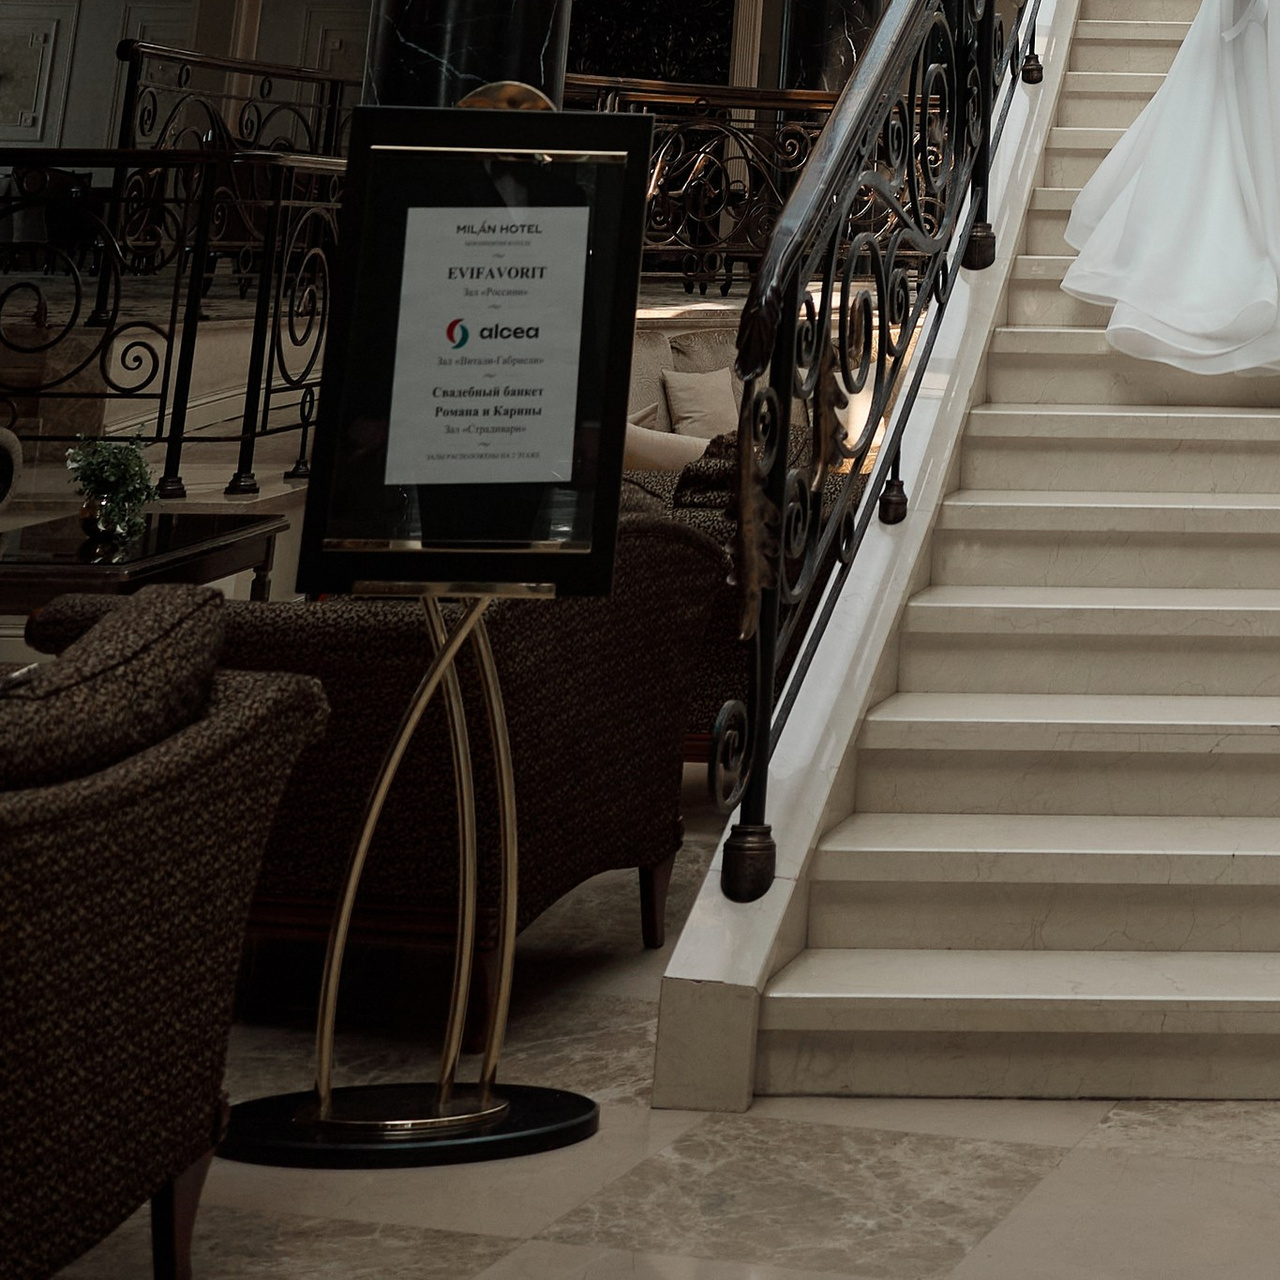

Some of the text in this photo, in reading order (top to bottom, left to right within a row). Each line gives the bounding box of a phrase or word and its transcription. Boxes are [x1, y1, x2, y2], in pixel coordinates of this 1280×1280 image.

[456, 221, 543, 236] MILÁN HOTEL
[447, 266, 547, 280] EVIFAVORIT
[463, 288, 479, 297] Зал
[479, 324, 540, 340] alcea
[437, 356, 453, 366] Зал
[432, 385, 544, 398] Свадебный банкет
[434, 405, 543, 419] Романа и Карины
[444, 425, 460, 434] Зал
